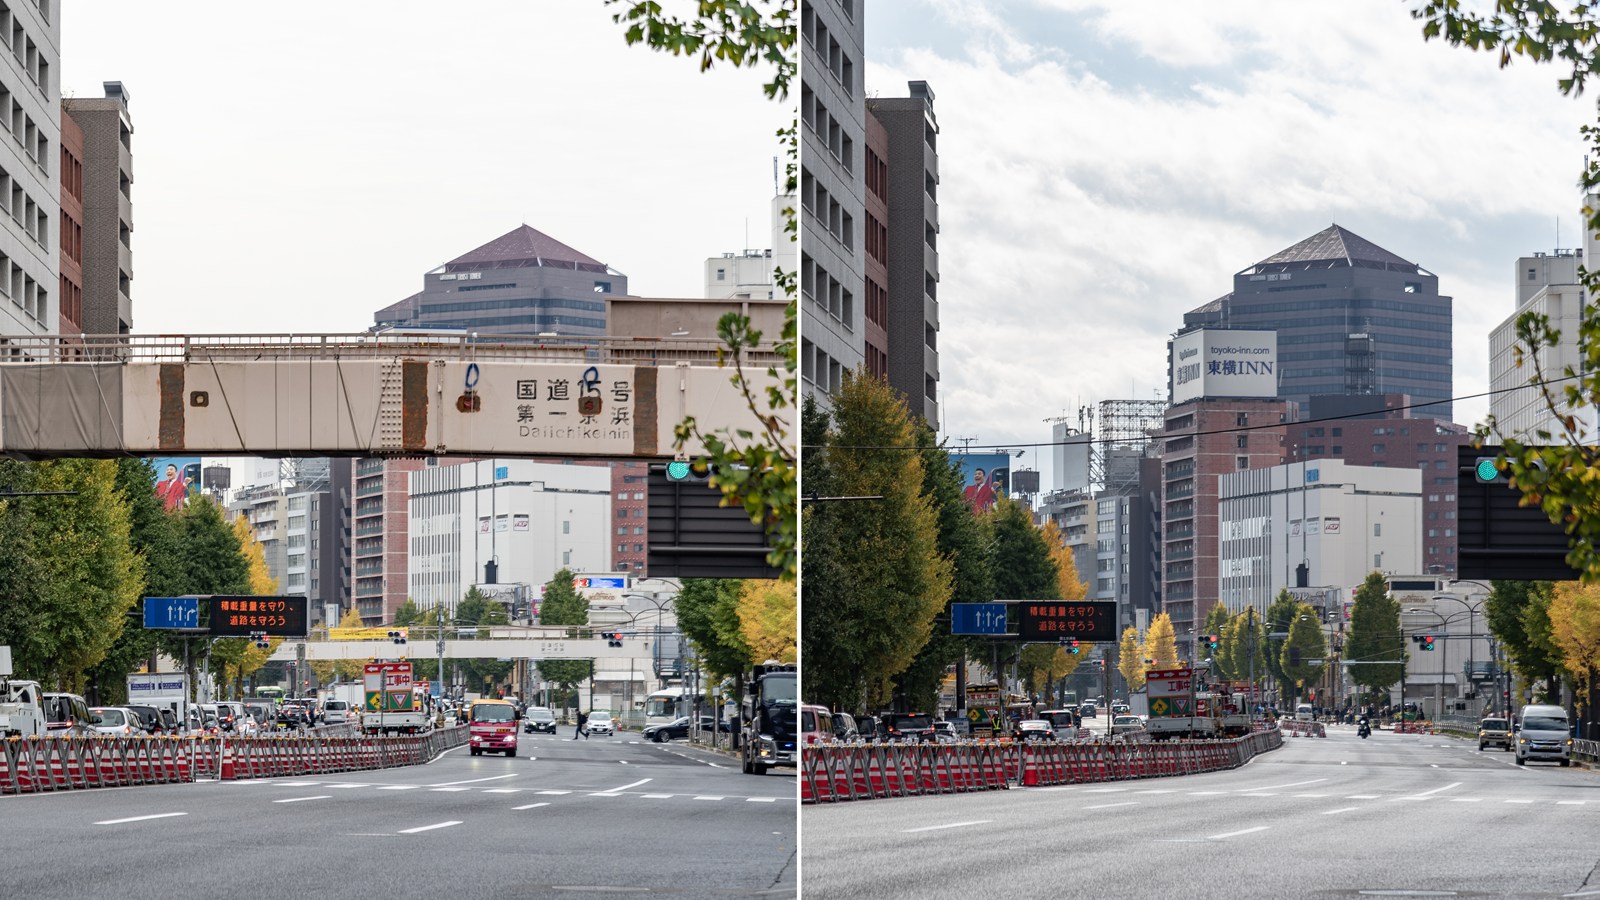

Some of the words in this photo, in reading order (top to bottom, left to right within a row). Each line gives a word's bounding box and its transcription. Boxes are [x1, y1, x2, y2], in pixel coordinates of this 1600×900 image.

[1210, 346, 1270, 356] toyoko-inn.com
[1207, 360, 1274, 376] 東横INN
[516, 379, 632, 402] 国道15号
[229, 615, 286, 626] 道路を守ろう
[1038, 620, 1095, 631] 道路を守ろう
[386, 674, 410, 687] 工事中
[1167, 680, 1191, 692] 工事中
